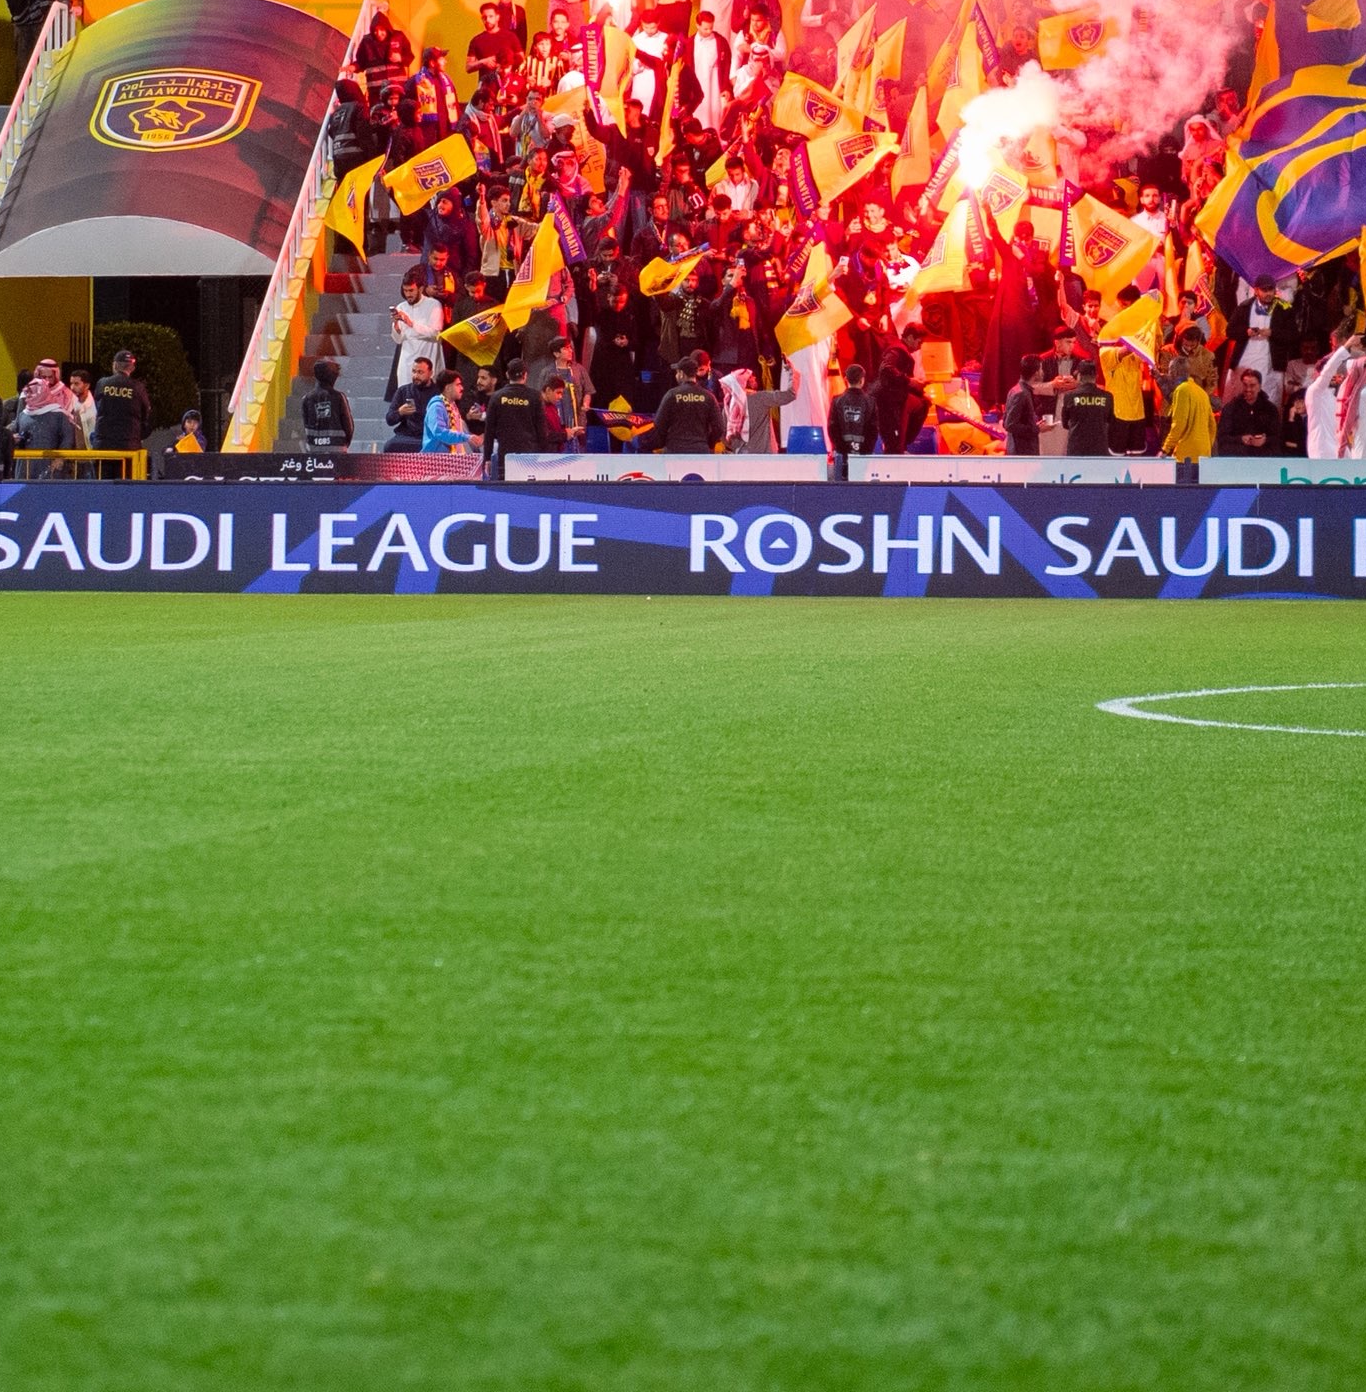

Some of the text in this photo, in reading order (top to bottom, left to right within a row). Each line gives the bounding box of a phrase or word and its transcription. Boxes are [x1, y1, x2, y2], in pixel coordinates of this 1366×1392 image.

[121, 78, 235, 93] نادي التعاون
[117, 86, 235, 102] ALTAAWOUN.FC
[103, 385, 134, 400] POLICE
[675, 393, 706, 404] Police
[500, 395, 530, 407] Police
[1073, 395, 1107, 407] POLICE
[279, 456, 335, 473] شماغ وغتر
[271, 512, 599, 573] LEAGUE
[689, 512, 1002, 575] ROSHN
[1044, 515, 1314, 578] SAUDI
